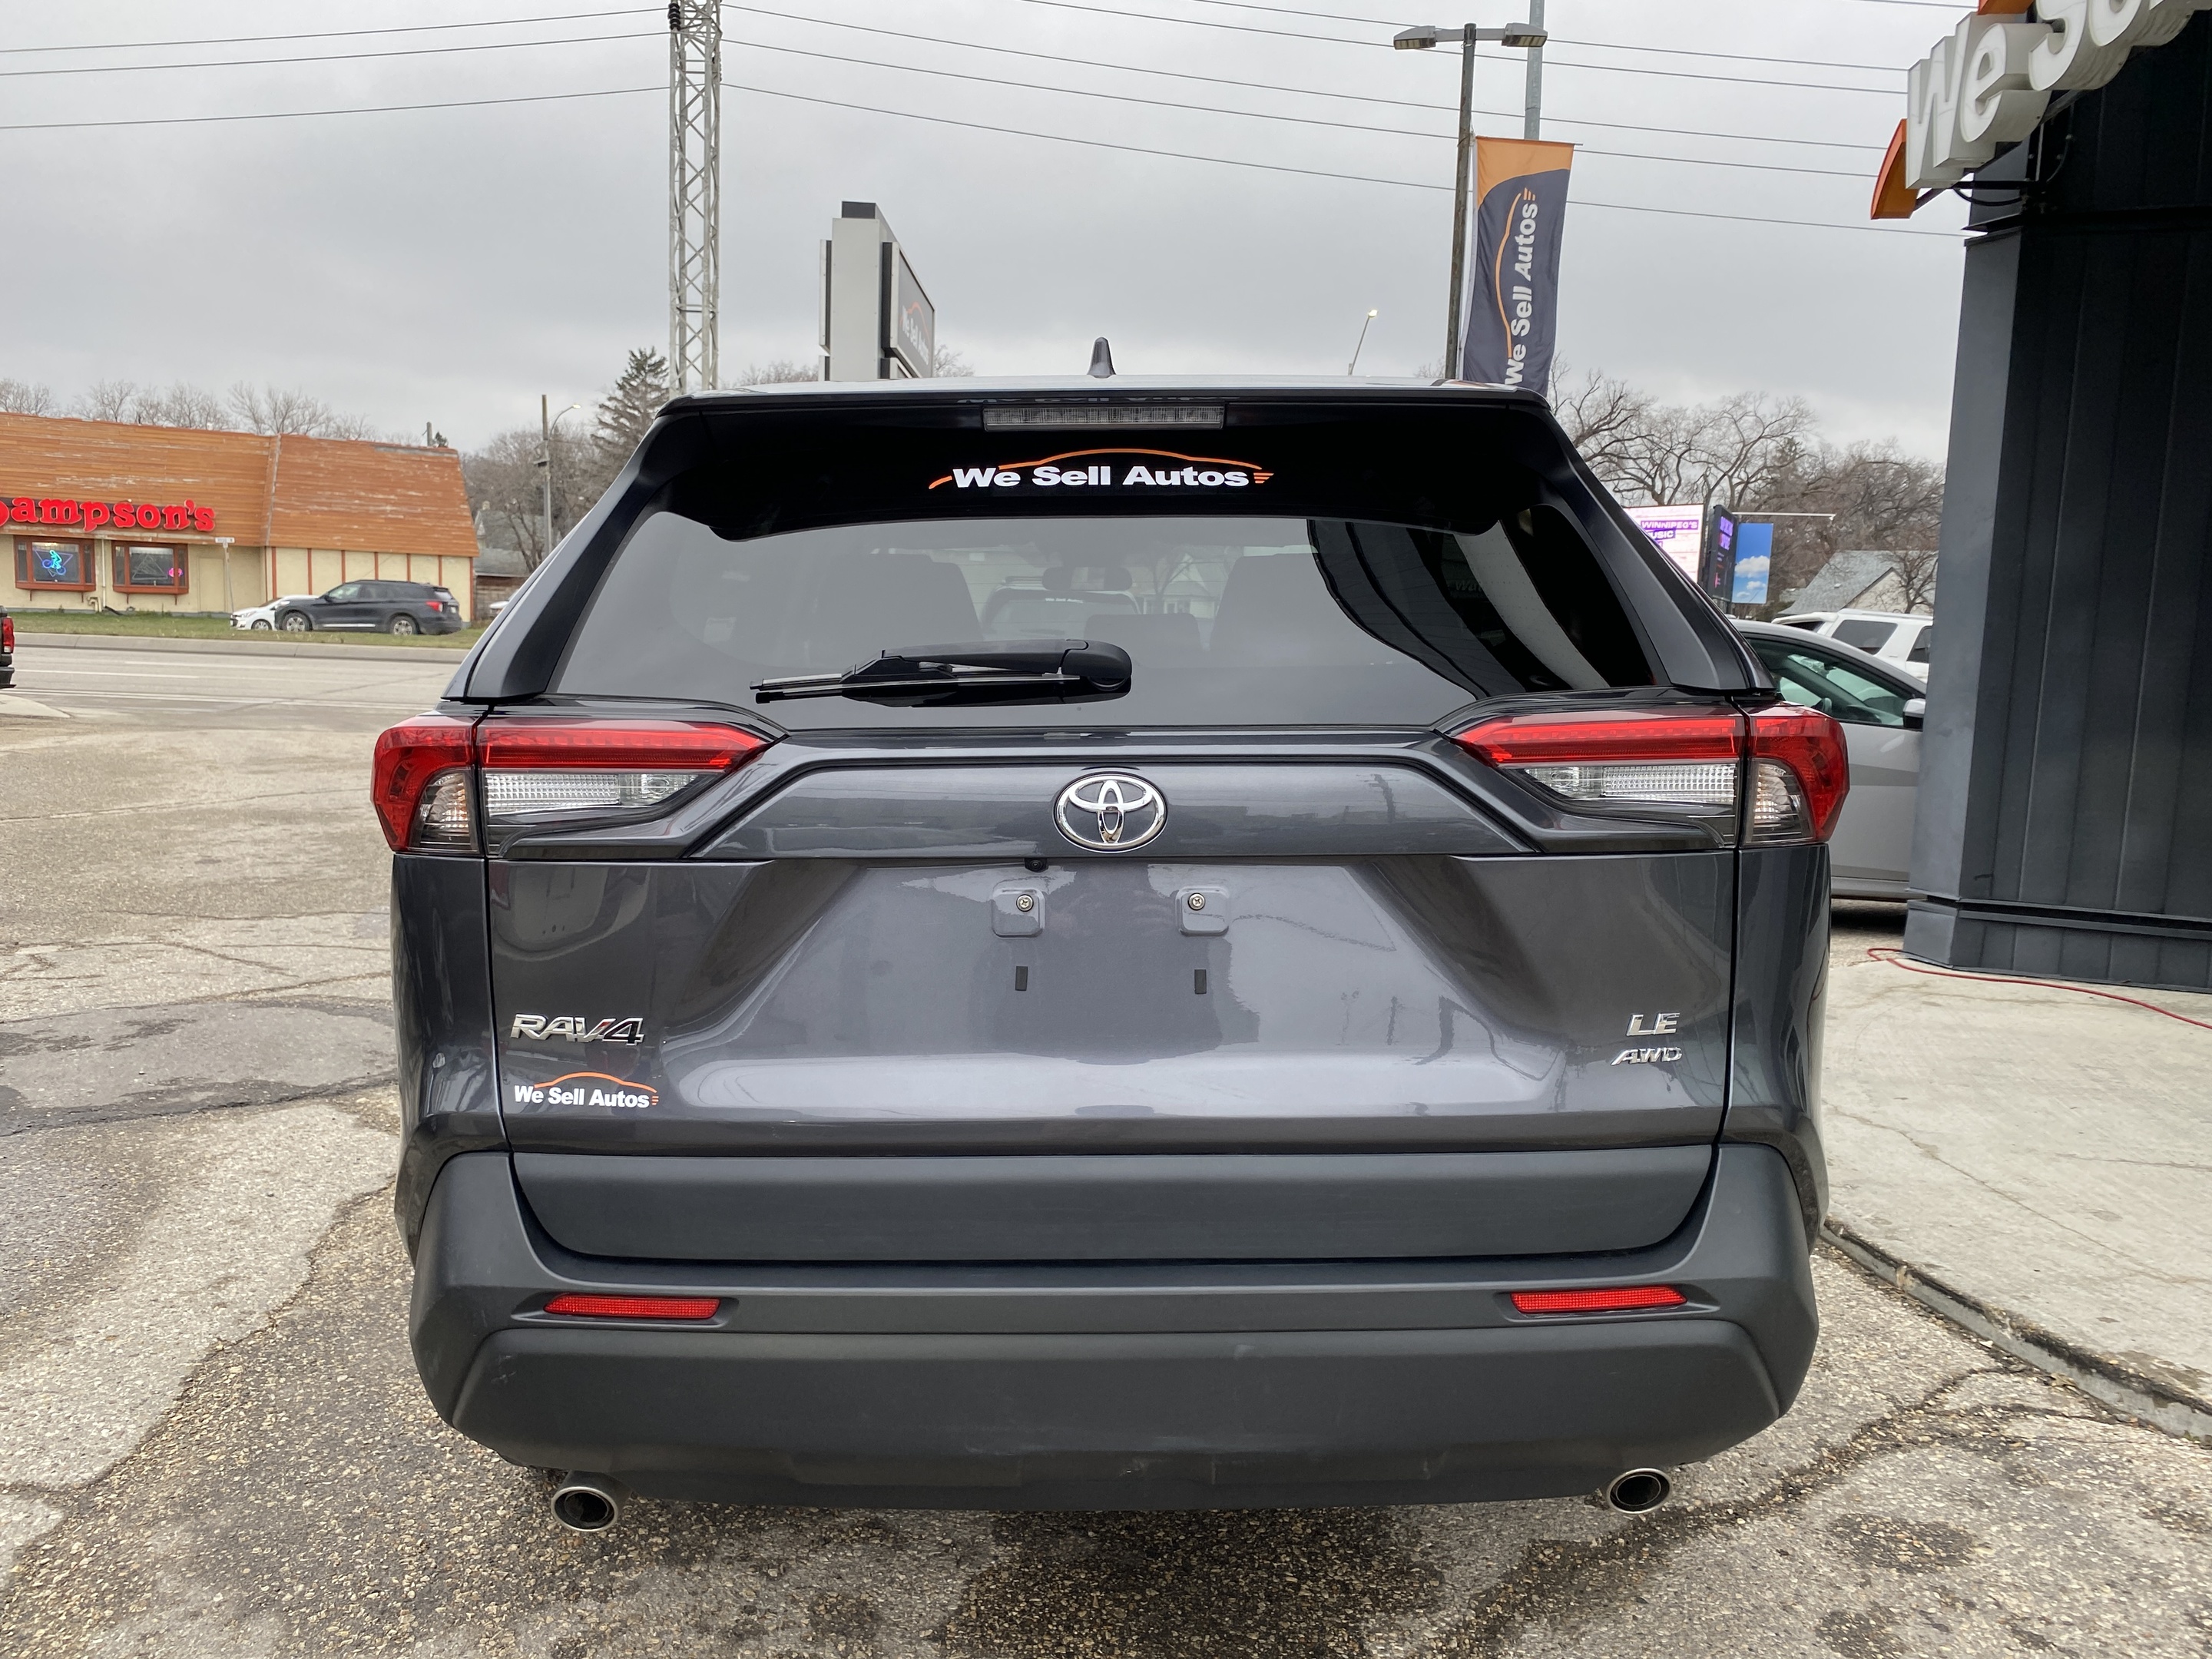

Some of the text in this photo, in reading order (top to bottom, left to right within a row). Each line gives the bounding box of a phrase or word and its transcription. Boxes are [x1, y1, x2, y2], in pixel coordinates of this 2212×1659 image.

[1906, 12, 2009, 190] We
[1505, 202, 1538, 385] We Sell Autos
[952, 465, 1249, 488] We Sell Autos
[1641, 521, 1698, 529] WINNIPEG'S
[510, 1013, 645, 1046] RAV4
[1626, 1012, 1681, 1037] LE
[1610, 1047, 1683, 1066] AWD
[514, 1084, 650, 1108] We Sell Autos
